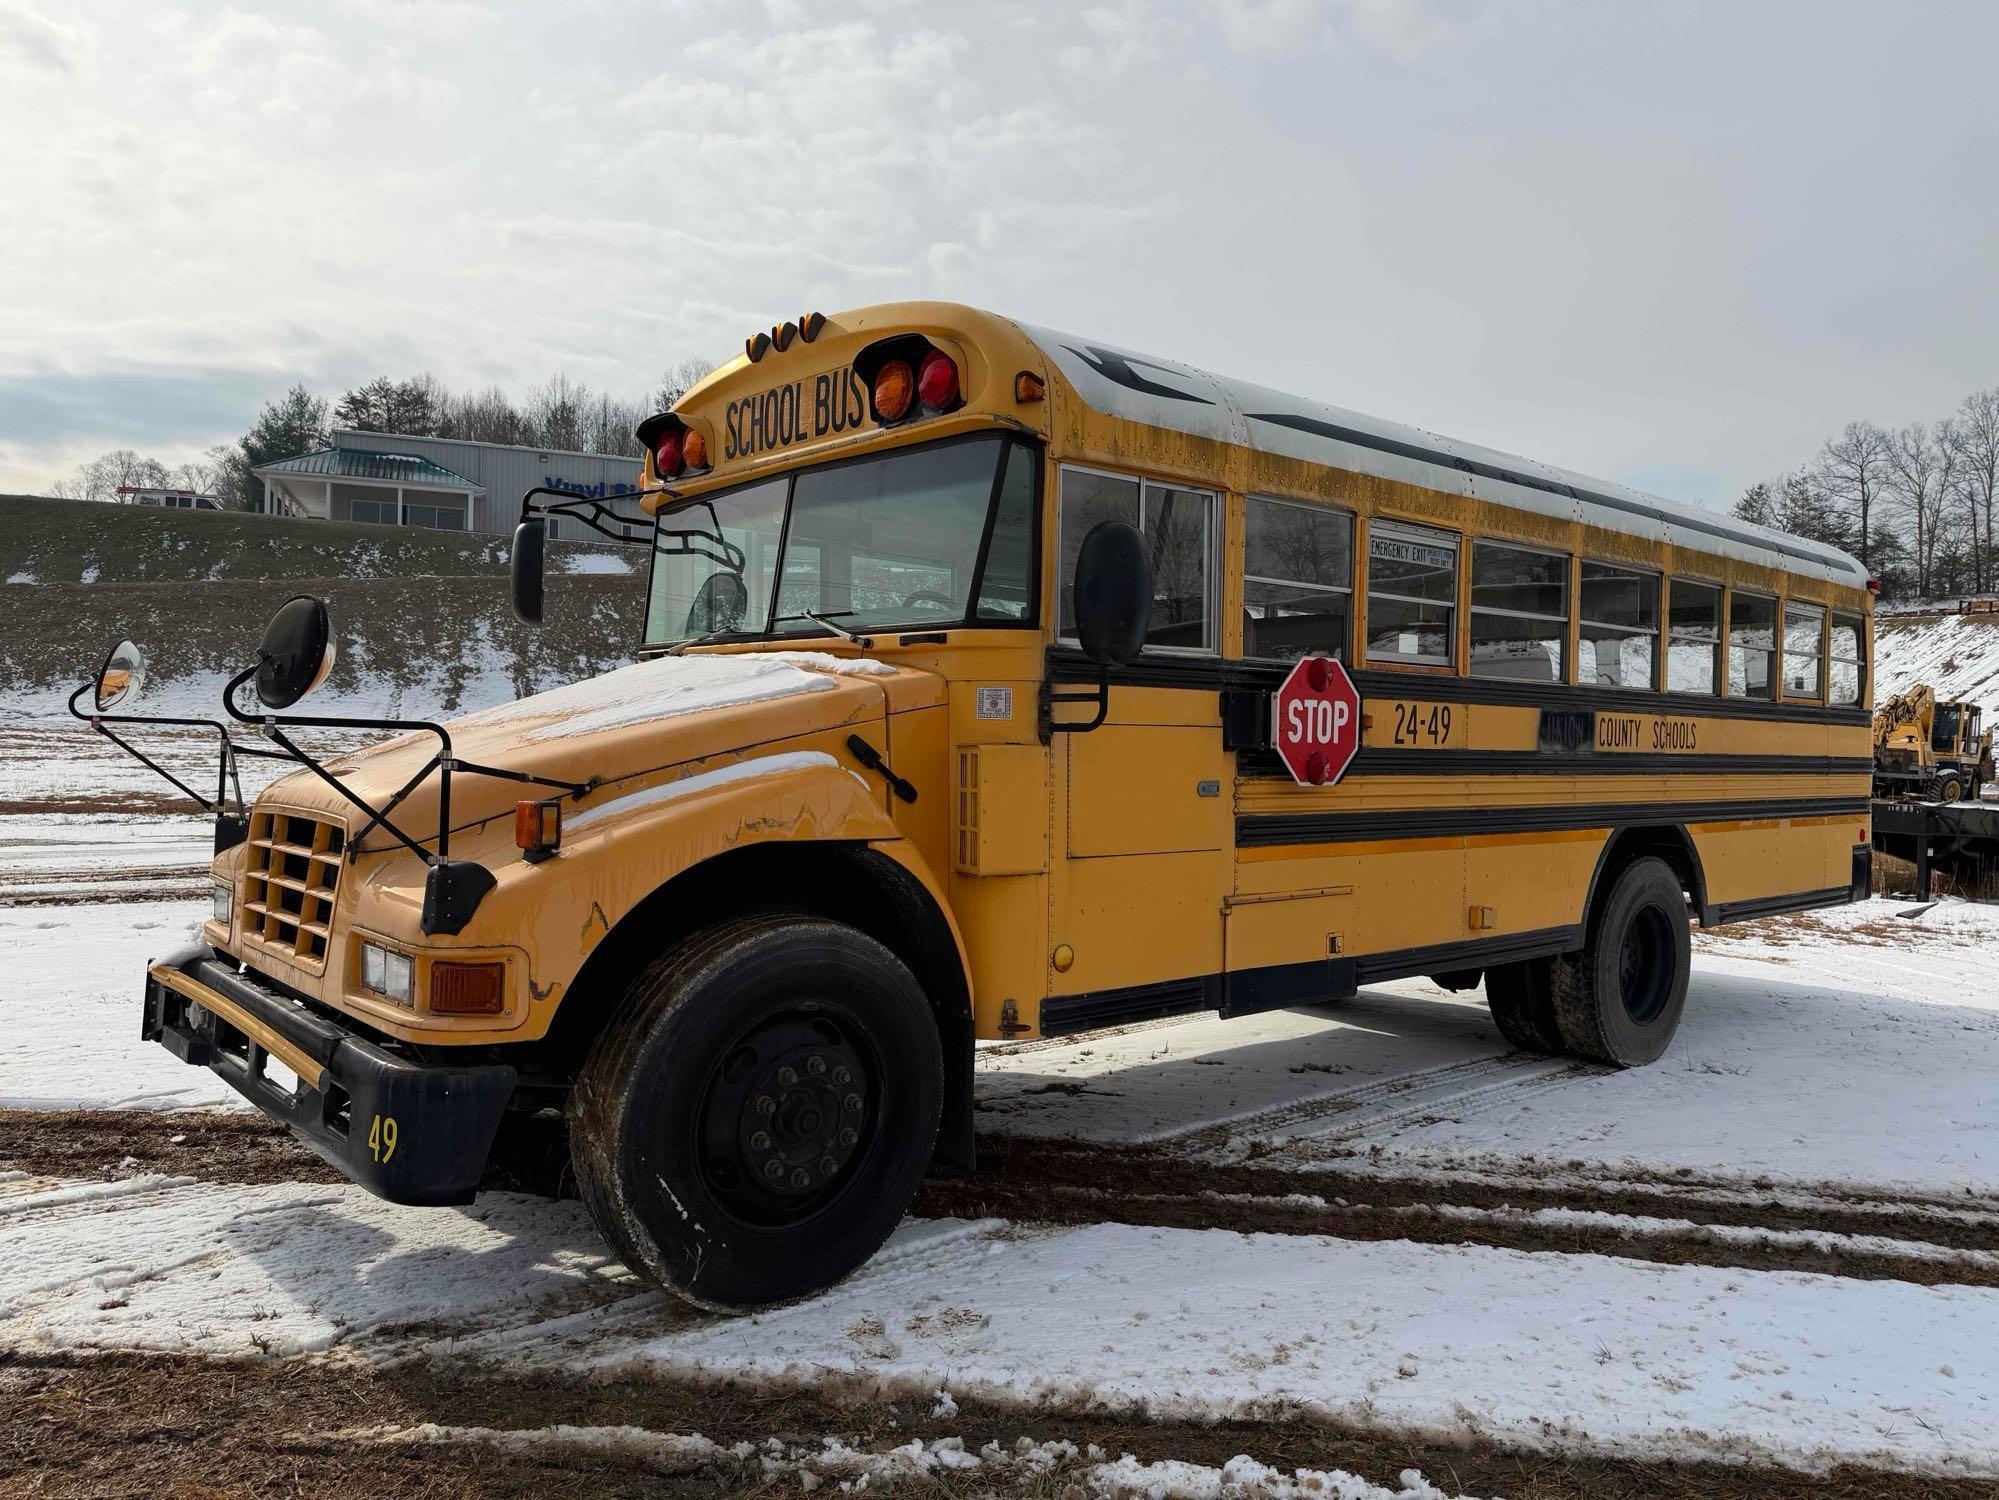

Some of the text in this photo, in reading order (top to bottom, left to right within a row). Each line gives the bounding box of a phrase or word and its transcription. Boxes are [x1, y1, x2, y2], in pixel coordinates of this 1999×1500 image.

[725, 367, 864, 460] SCHOOL BUS
[545, 476, 606, 499] Vinyl
[1371, 540, 1410, 560] EMERGENCY
[1412, 547, 1427, 563] EXIT
[1287, 698, 1349, 744] STOP
[1393, 703, 1451, 745] 24-49
[1599, 717, 1641, 748] COUNTY
[1652, 720, 1697, 750] SCHOOLS
[368, 1114, 398, 1164] 49
